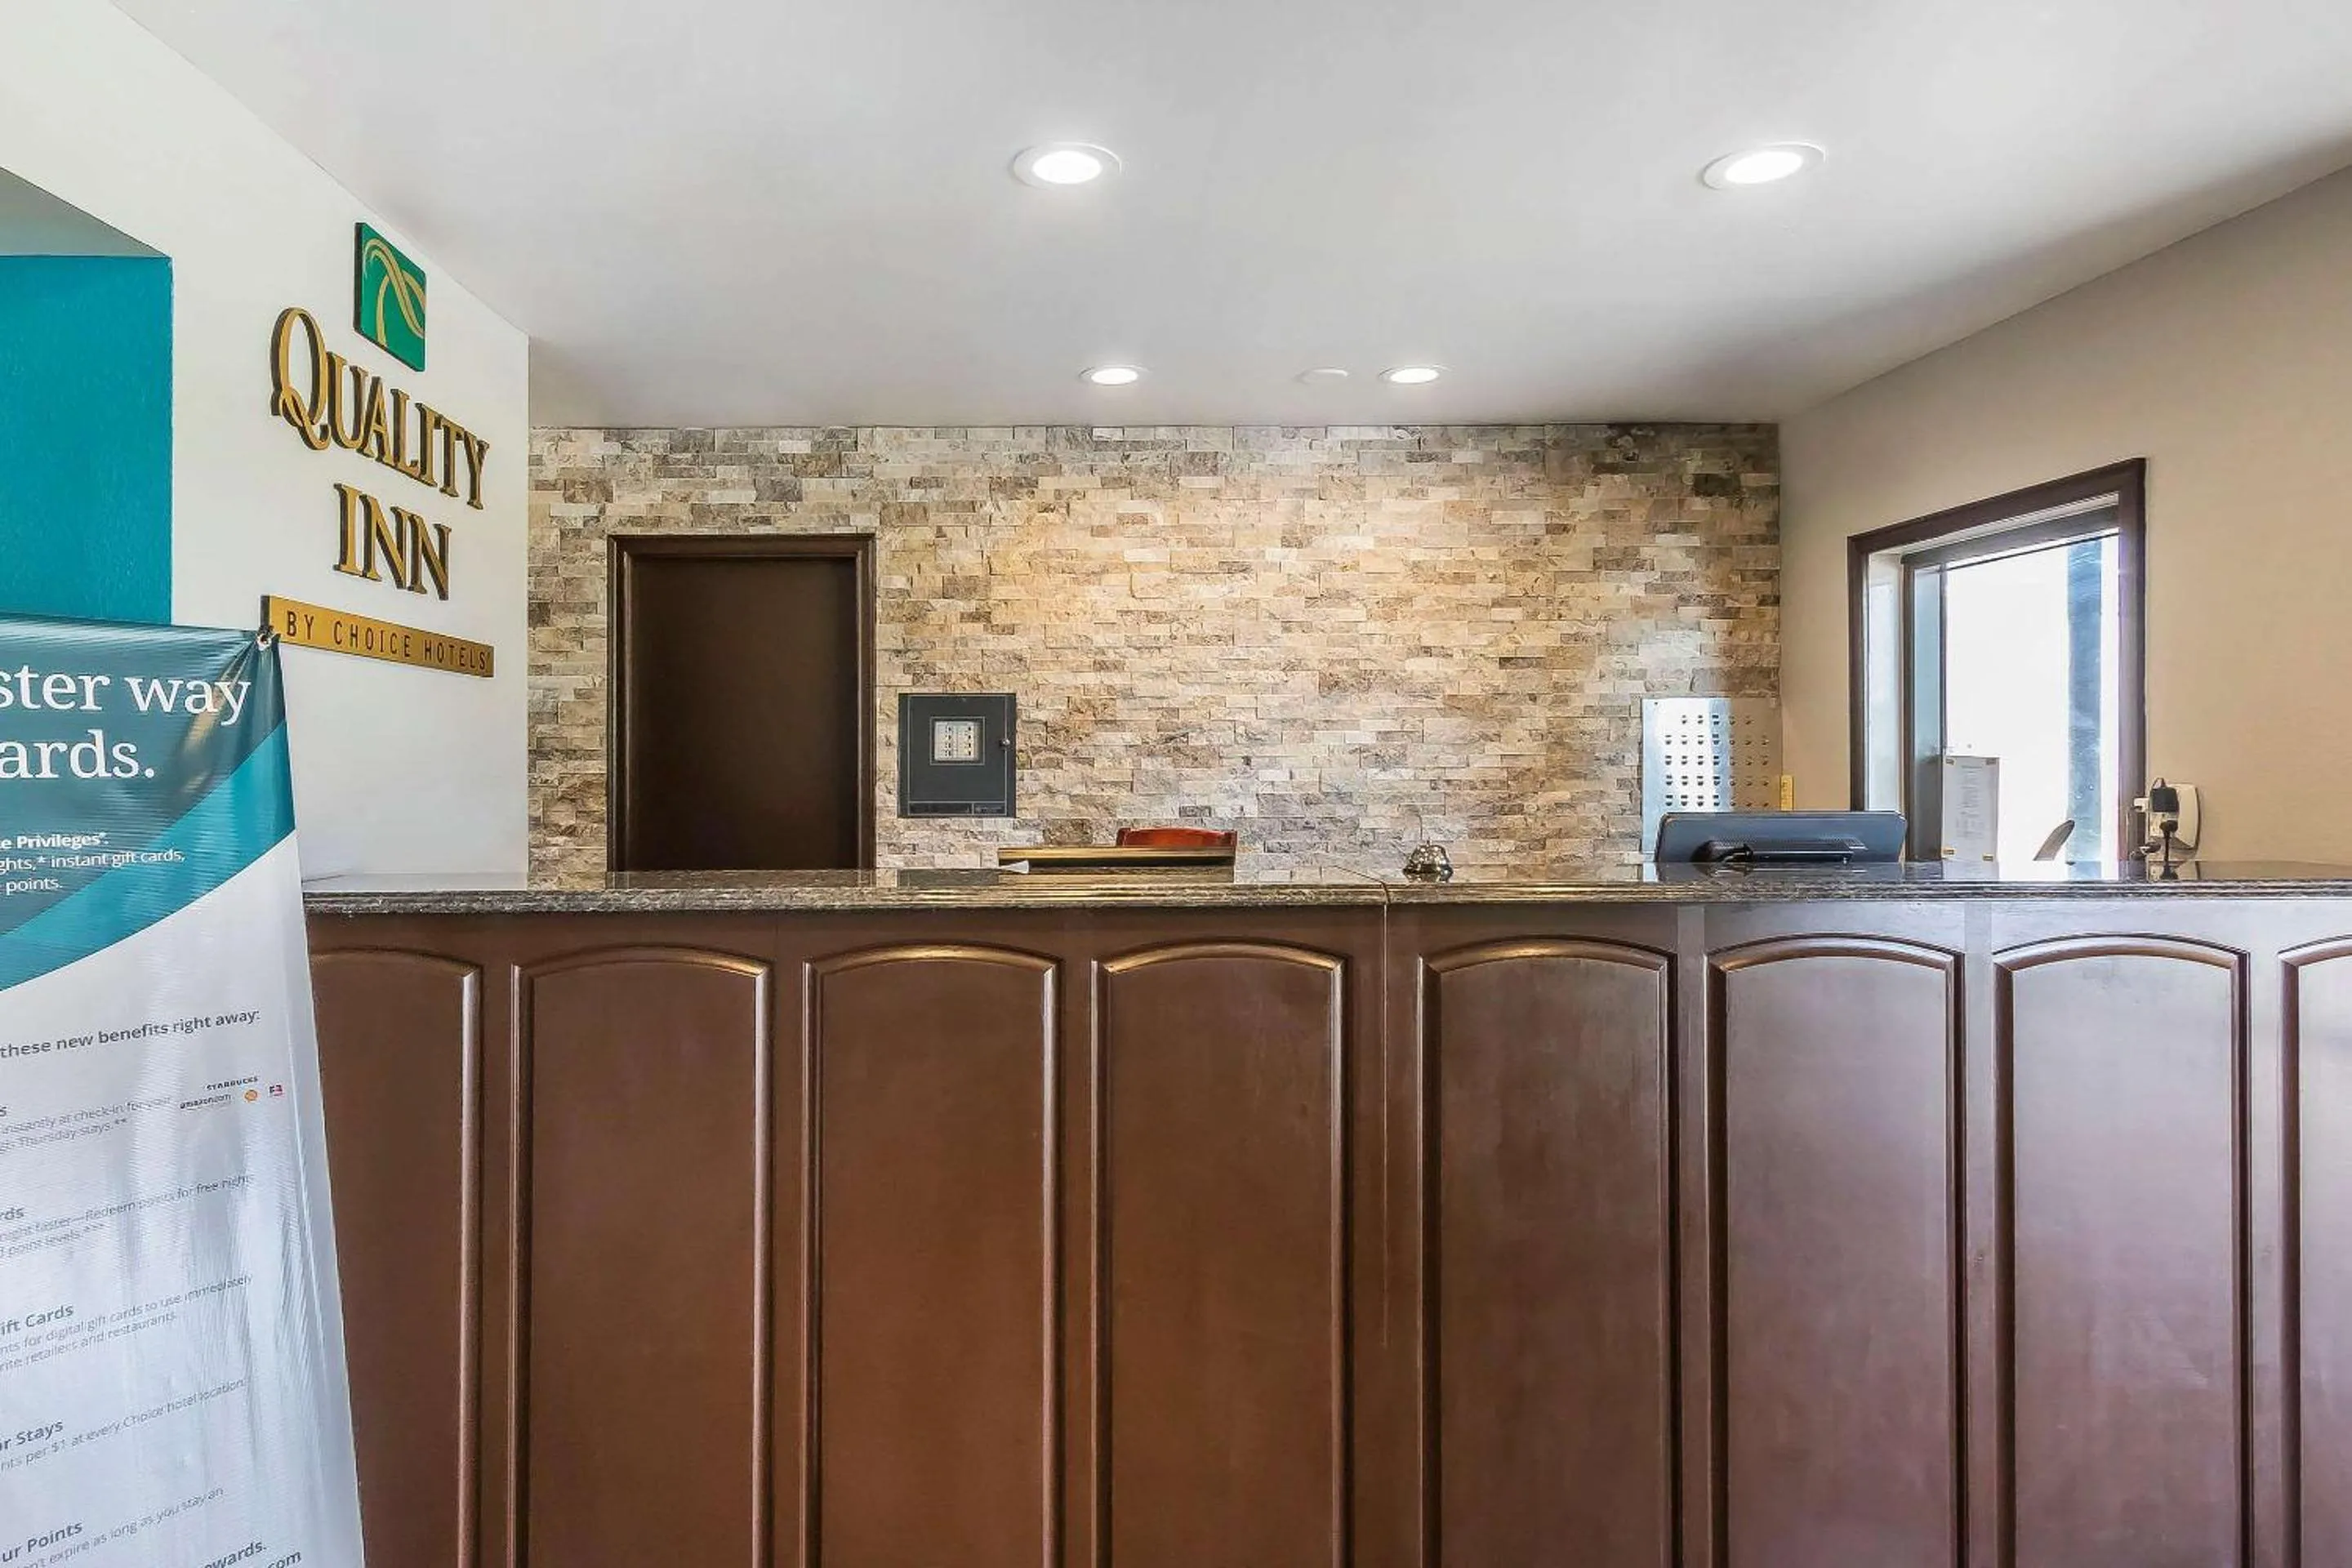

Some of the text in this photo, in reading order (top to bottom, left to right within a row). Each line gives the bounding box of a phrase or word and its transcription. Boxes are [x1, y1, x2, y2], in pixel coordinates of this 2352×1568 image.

[270, 306, 490, 510] QUALITY
[333, 483, 452, 601] INN
[287, 610, 487, 670] BY CHOICE HOTELS
[124, 676, 252, 725] way
[0, 728, 155, 779] ards.
[51, 853, 108, 868] instant
[112, 851, 137, 868] gift
[140, 848, 186, 863] cards,
[6, 877, 64, 896] points.
[0, 1040, 51, 1058] these
[56, 1034, 94, 1051] new
[98, 1022, 169, 1045] benefits
[172, 1015, 212, 1034] right
[25, 1305, 74, 1328] Cards
[109, 1306, 144, 1324] cards
[16, 1419, 65, 1446] Stays
[28, 1521, 84, 1553] Points
